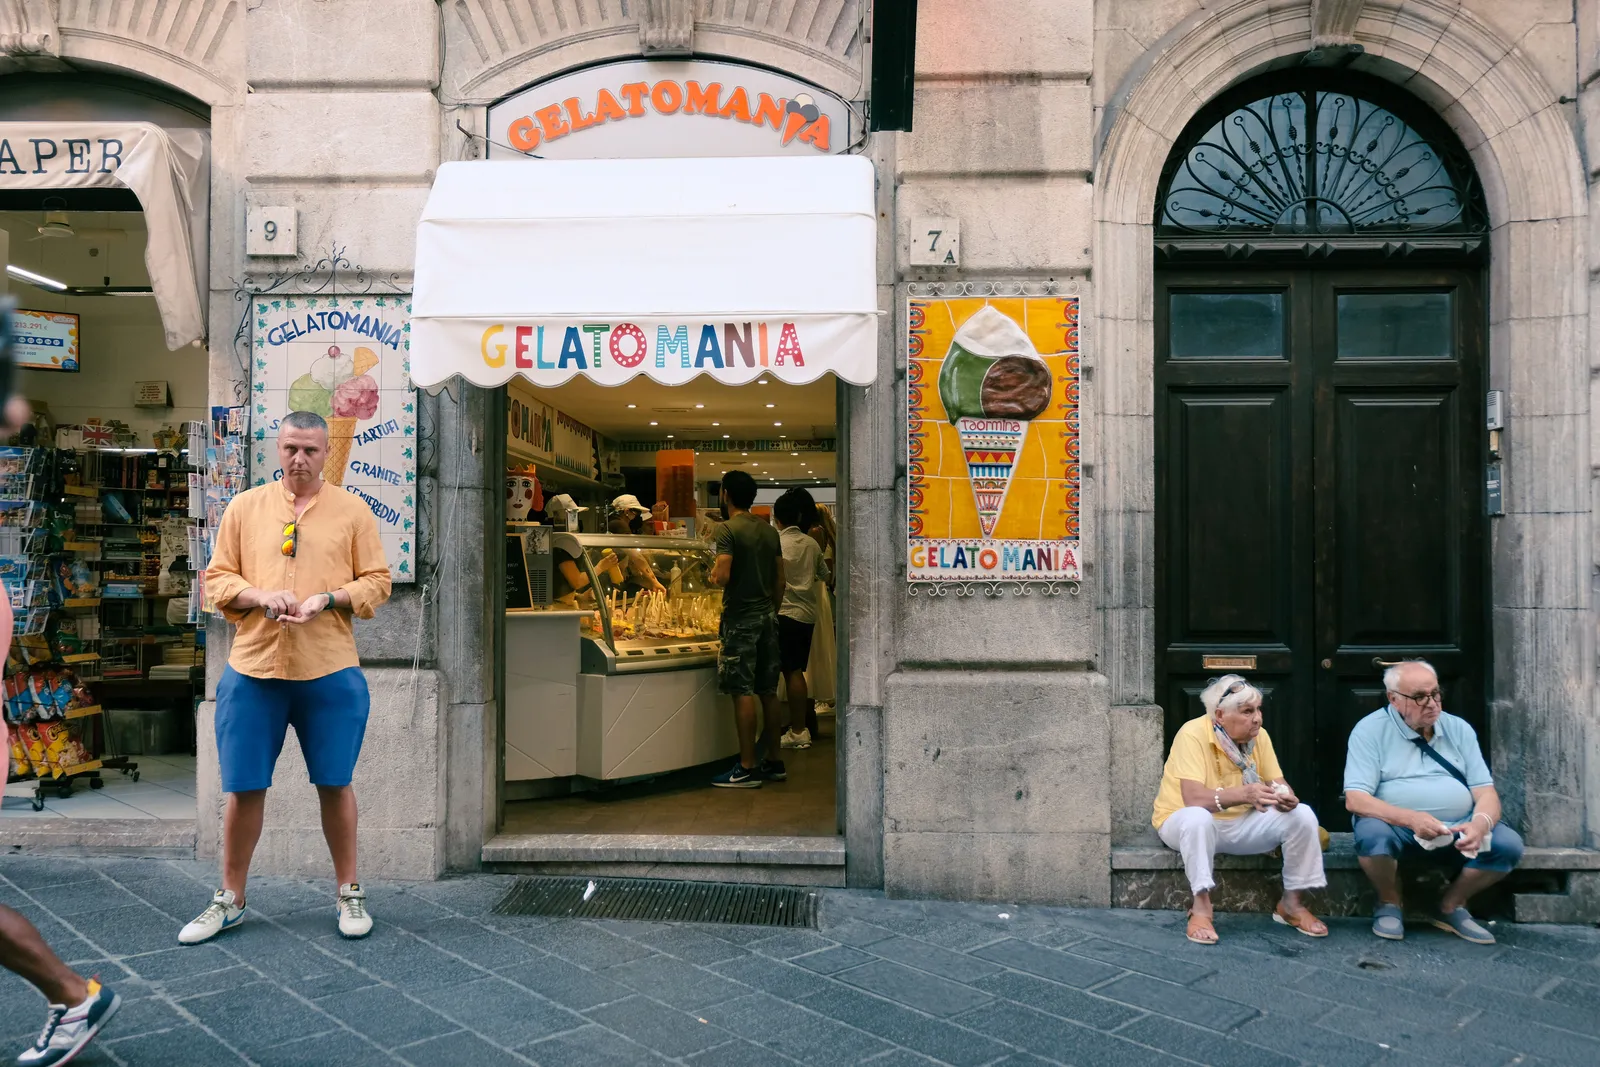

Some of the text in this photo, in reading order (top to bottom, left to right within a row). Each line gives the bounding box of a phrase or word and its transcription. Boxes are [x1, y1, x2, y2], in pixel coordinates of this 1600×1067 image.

[507, 80, 831, 151] GELATOMANIA
[0, 138, 123, 174] APER
[264, 220, 277, 241] 9
[928, 230, 942, 252] 7
[267, 311, 401, 350] GELATOMANIA
[481, 323, 805, 369] GELATOMANIA
[353, 419, 400, 446] TARTUFI
[961, 419, 1020, 432] Taormina
[350, 461, 402, 486] GRANITE
[910, 547, 1078, 571] GELATOMANIA
